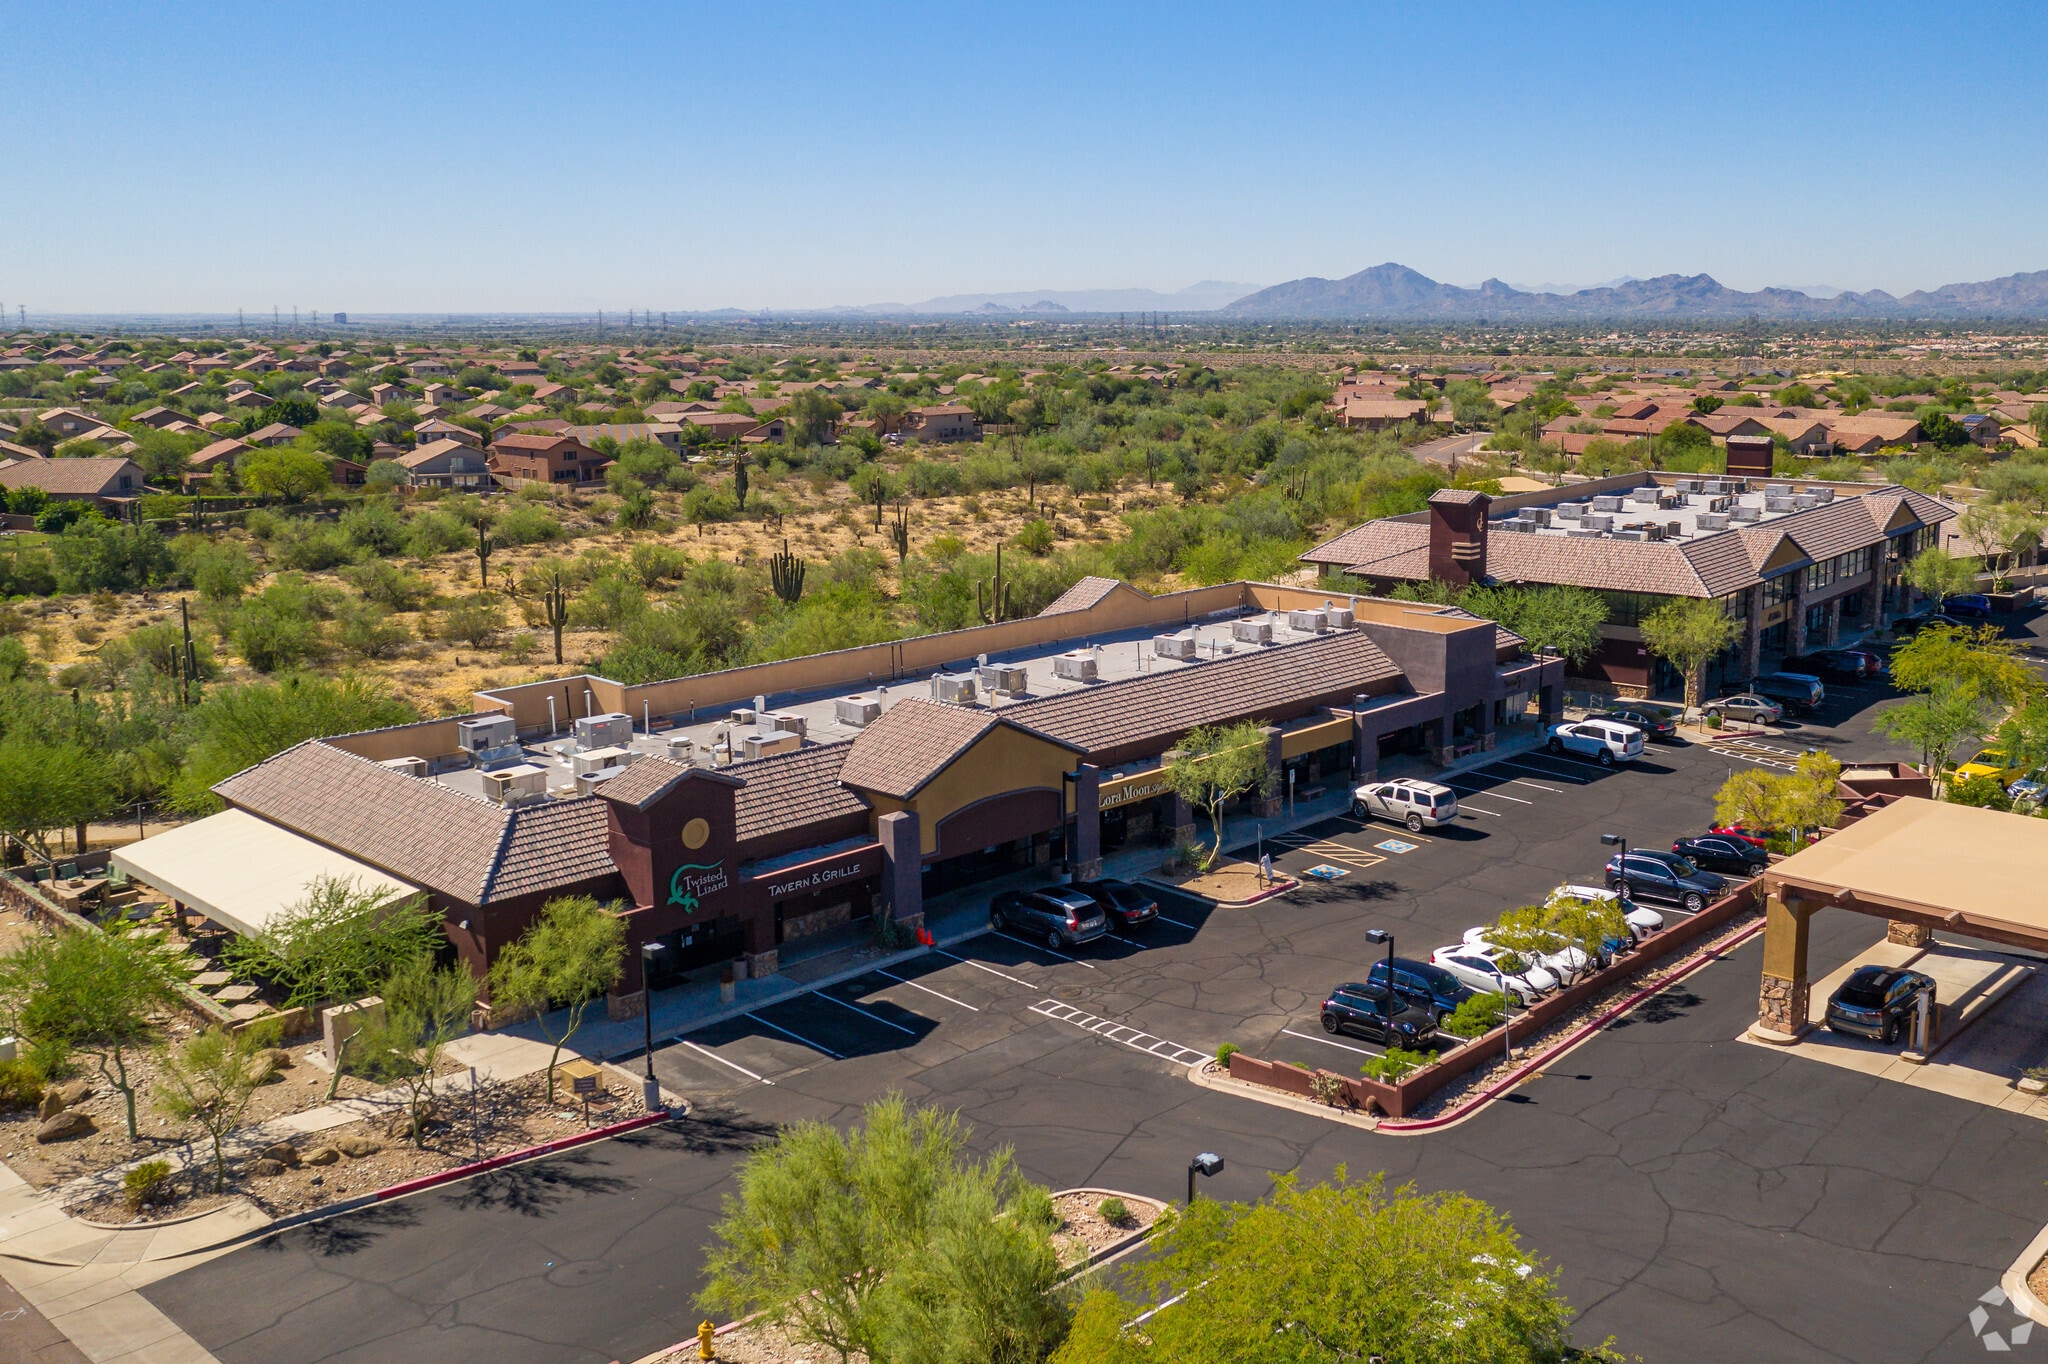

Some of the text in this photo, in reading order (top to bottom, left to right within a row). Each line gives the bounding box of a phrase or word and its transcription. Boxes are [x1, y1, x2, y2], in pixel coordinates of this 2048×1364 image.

[1098, 793, 1121, 808] Lora
[1122, 785, 1150, 801] Moon
[683, 867, 723, 890] Twisted
[696, 875, 728, 897] Lizard
[768, 864, 860, 896] TAVERN & GRILLE
